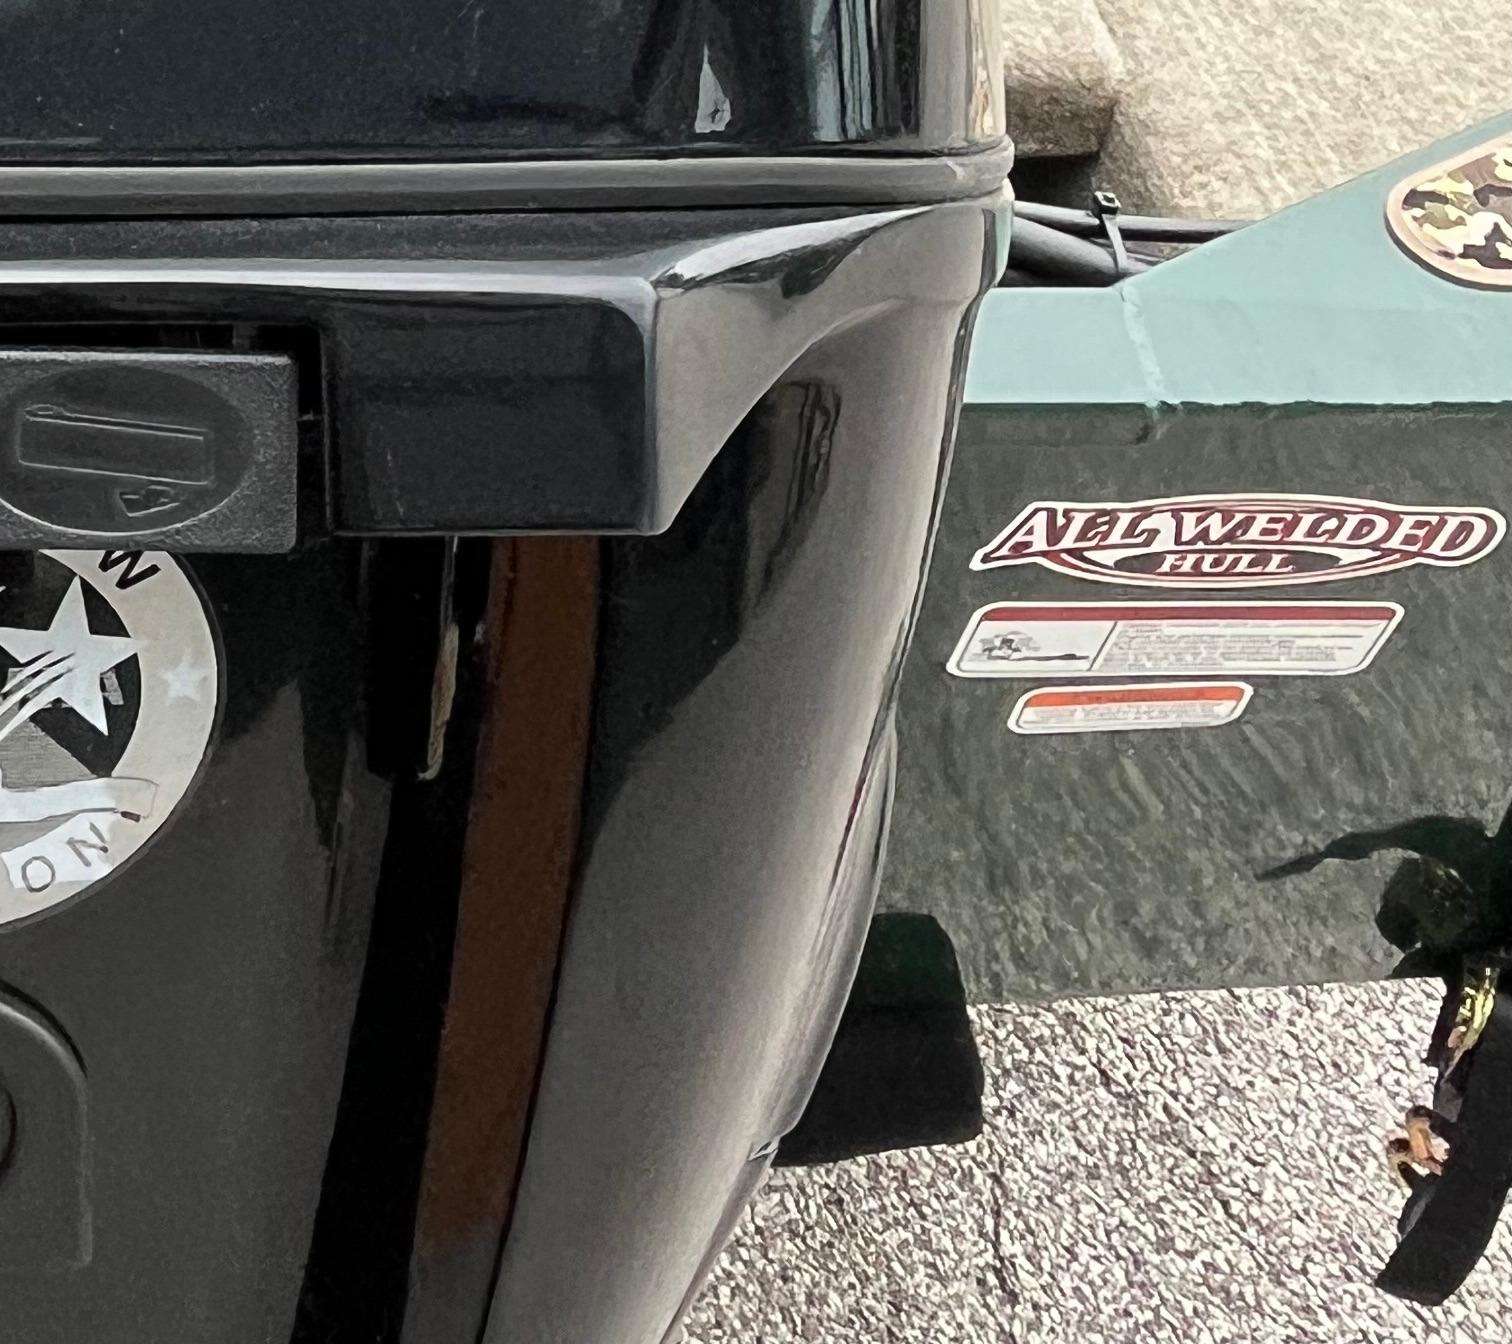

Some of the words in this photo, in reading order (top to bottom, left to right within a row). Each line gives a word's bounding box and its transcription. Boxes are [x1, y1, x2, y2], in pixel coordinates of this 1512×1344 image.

[1008, 510, 1166, 554] ALL
[1172, 511, 1494, 558] WELDED
[1154, 552, 1296, 575] HULL
